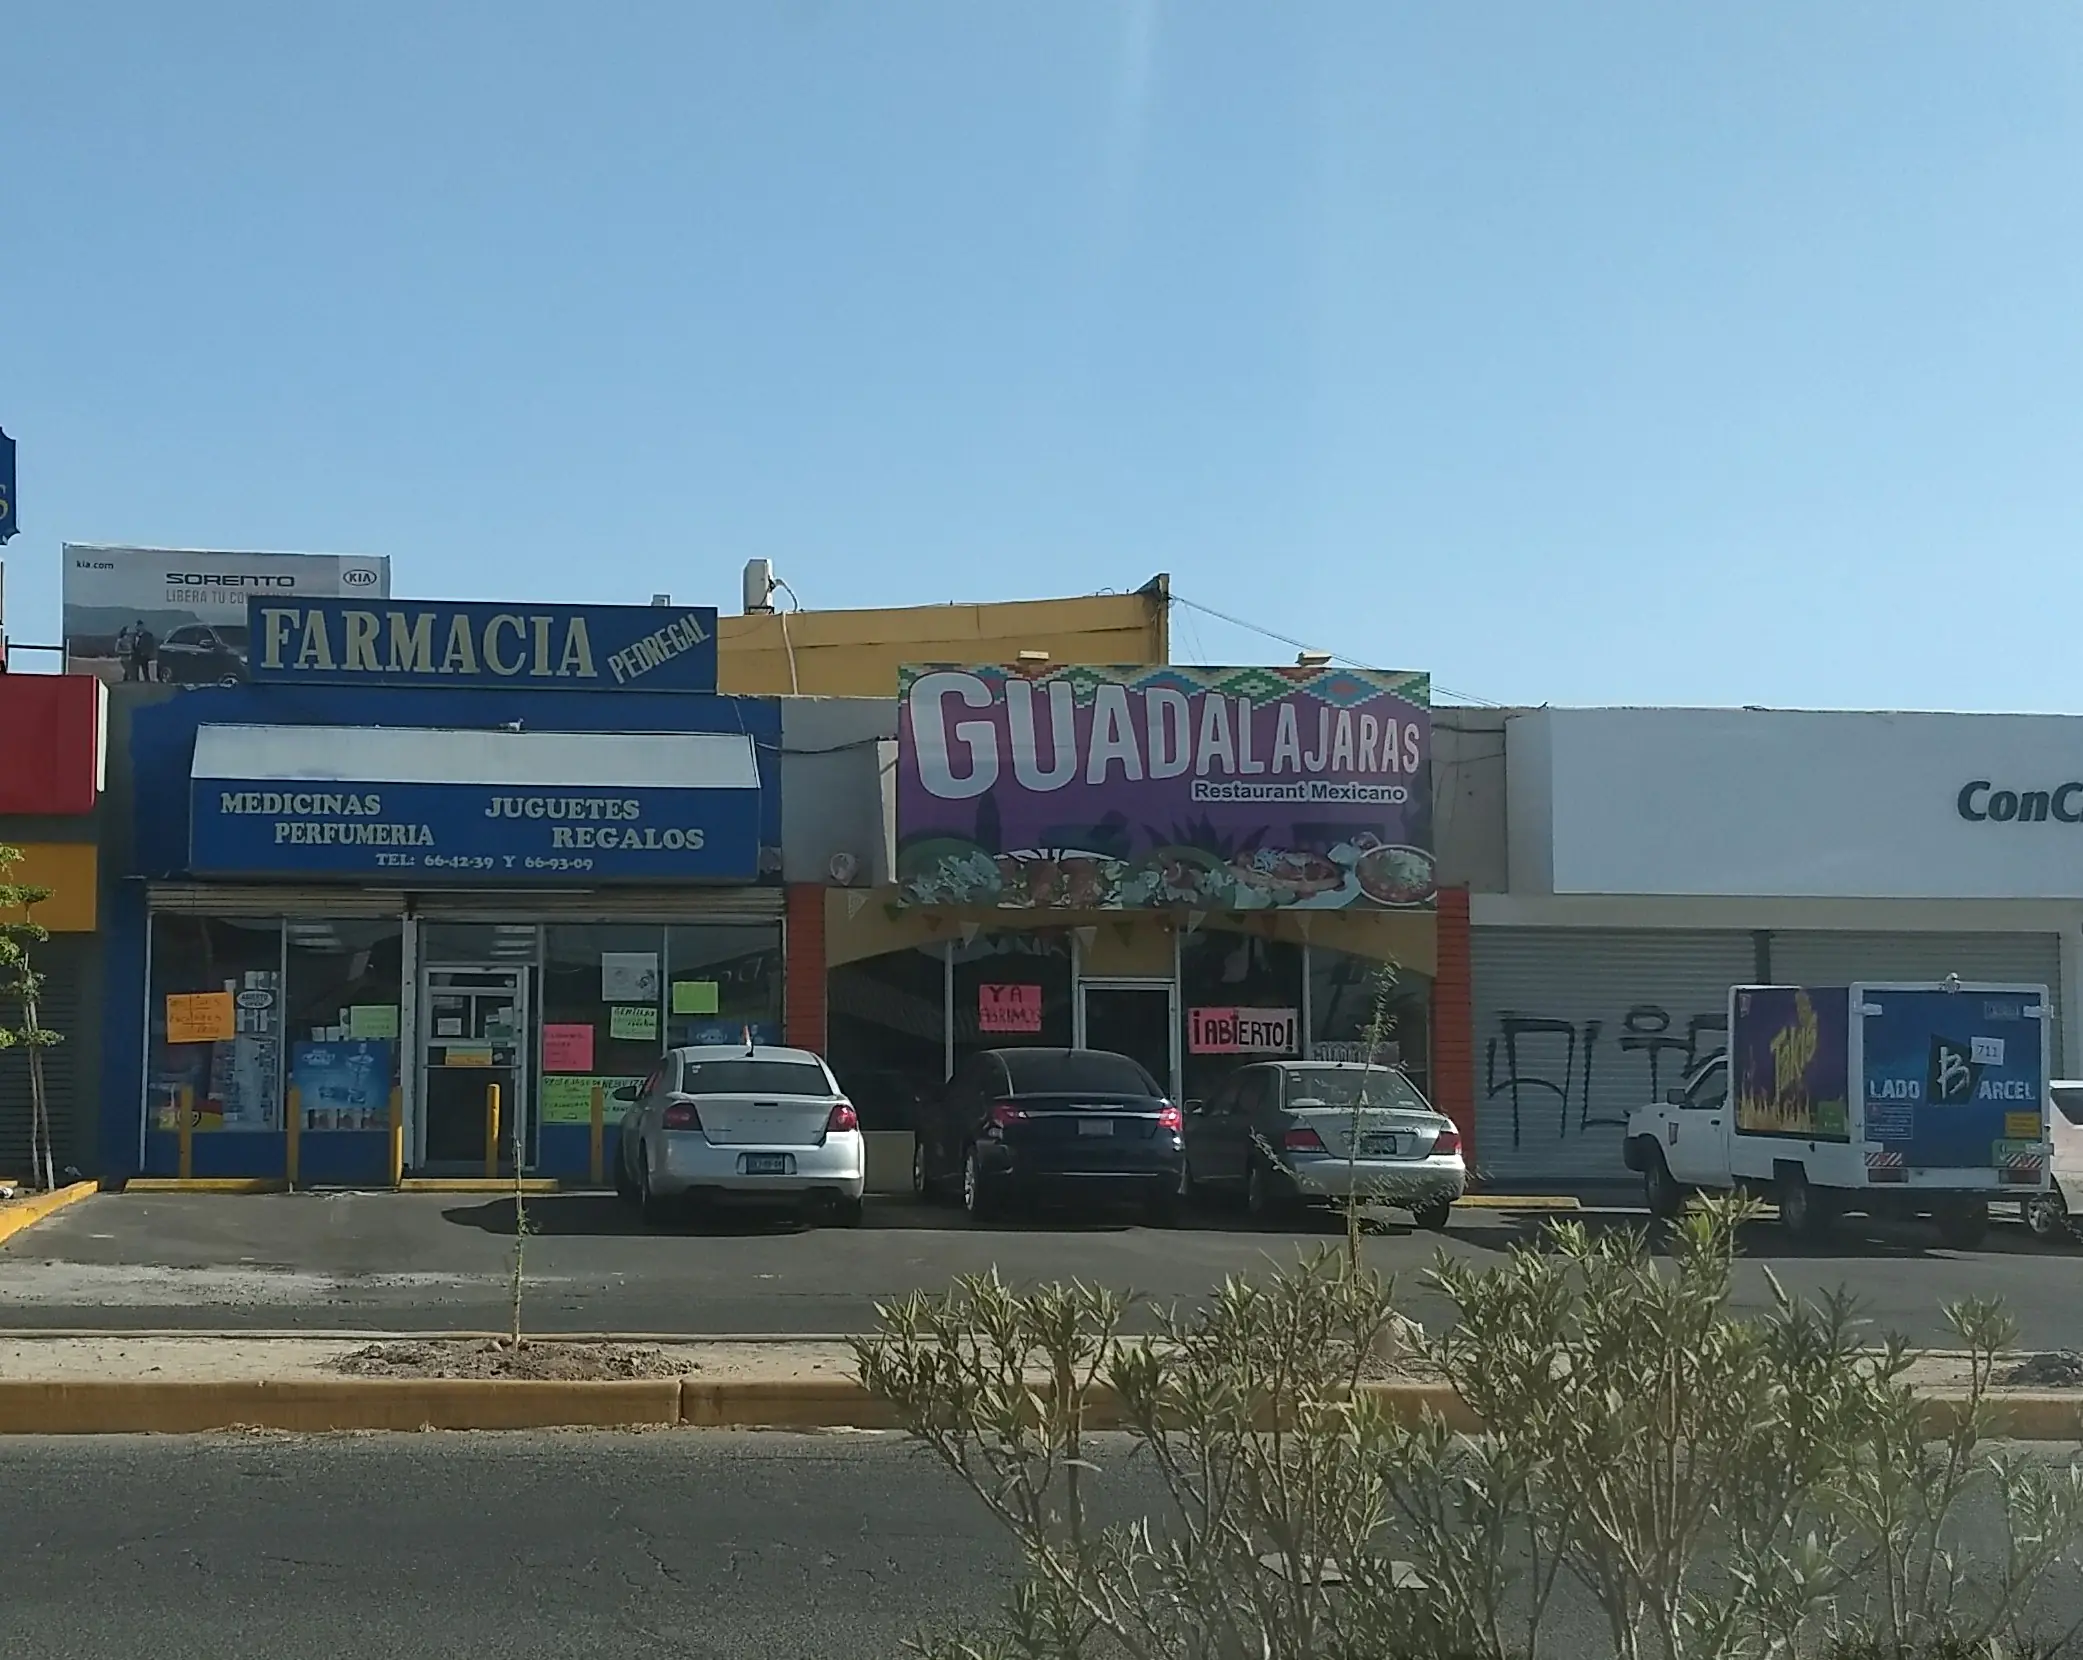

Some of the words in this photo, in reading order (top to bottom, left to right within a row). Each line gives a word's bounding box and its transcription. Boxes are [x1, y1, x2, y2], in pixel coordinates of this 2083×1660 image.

[76, 560, 114, 569] kia.com
[166, 573, 295, 587] SORENTO
[166, 588, 207, 603] LIBERA
[211, 590, 225, 604] TU
[260, 608, 597, 678] FARMACIA
[606, 613, 711, 685] PEDREGAL
[909, 671, 1420, 800] GUADALAJARAS
[1193, 782, 1305, 800] Restaurant
[1310, 783, 1406, 801] Mexicano
[1958, 780, 2083, 822] ConC
[220, 792, 381, 816] MEDICINAS
[485, 797, 640, 820] JUGUETES
[275, 822, 435, 847] PERFUMERIA
[552, 827, 704, 850] REGALOS
[376, 853, 414, 867] TEL:
[503, 855, 517, 868] Y
[988, 986, 1022, 1003] YA
[1977, 1045, 1998, 1057] 711
[1870, 1079, 1920, 1099] LADO
[1979, 1080, 2036, 1100] ARCEL
